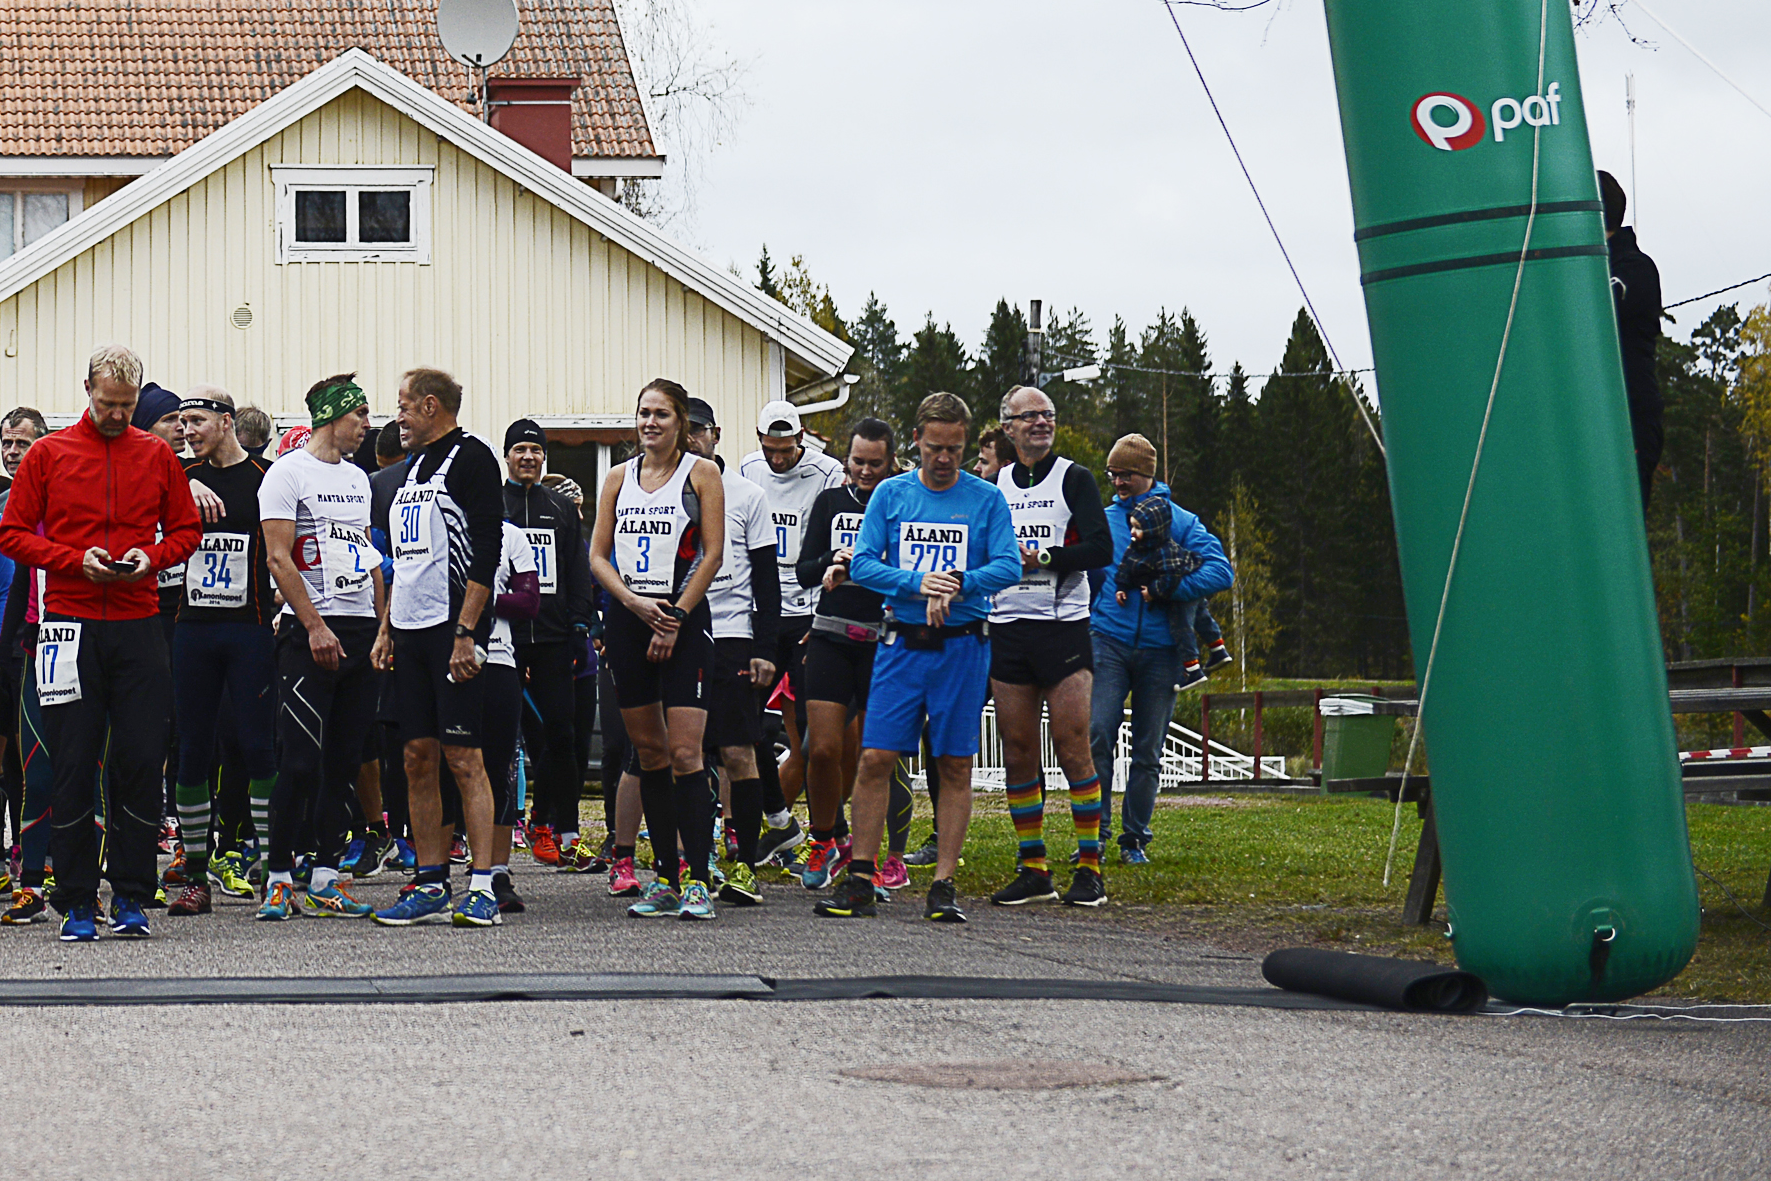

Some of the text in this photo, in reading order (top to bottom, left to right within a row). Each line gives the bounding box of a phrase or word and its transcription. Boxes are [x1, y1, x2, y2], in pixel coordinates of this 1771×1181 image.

[1491, 81, 1561, 142] paf
[395, 490, 434, 505] ÅLAND
[329, 522, 368, 547] ÅLAND
[400, 505, 421, 543] 30
[619, 518, 672, 535] ÅLAND
[904, 524, 963, 543] ÅLAND
[202, 553, 232, 589] 34
[636, 536, 650, 573] 3
[42, 645, 59, 685] 17
